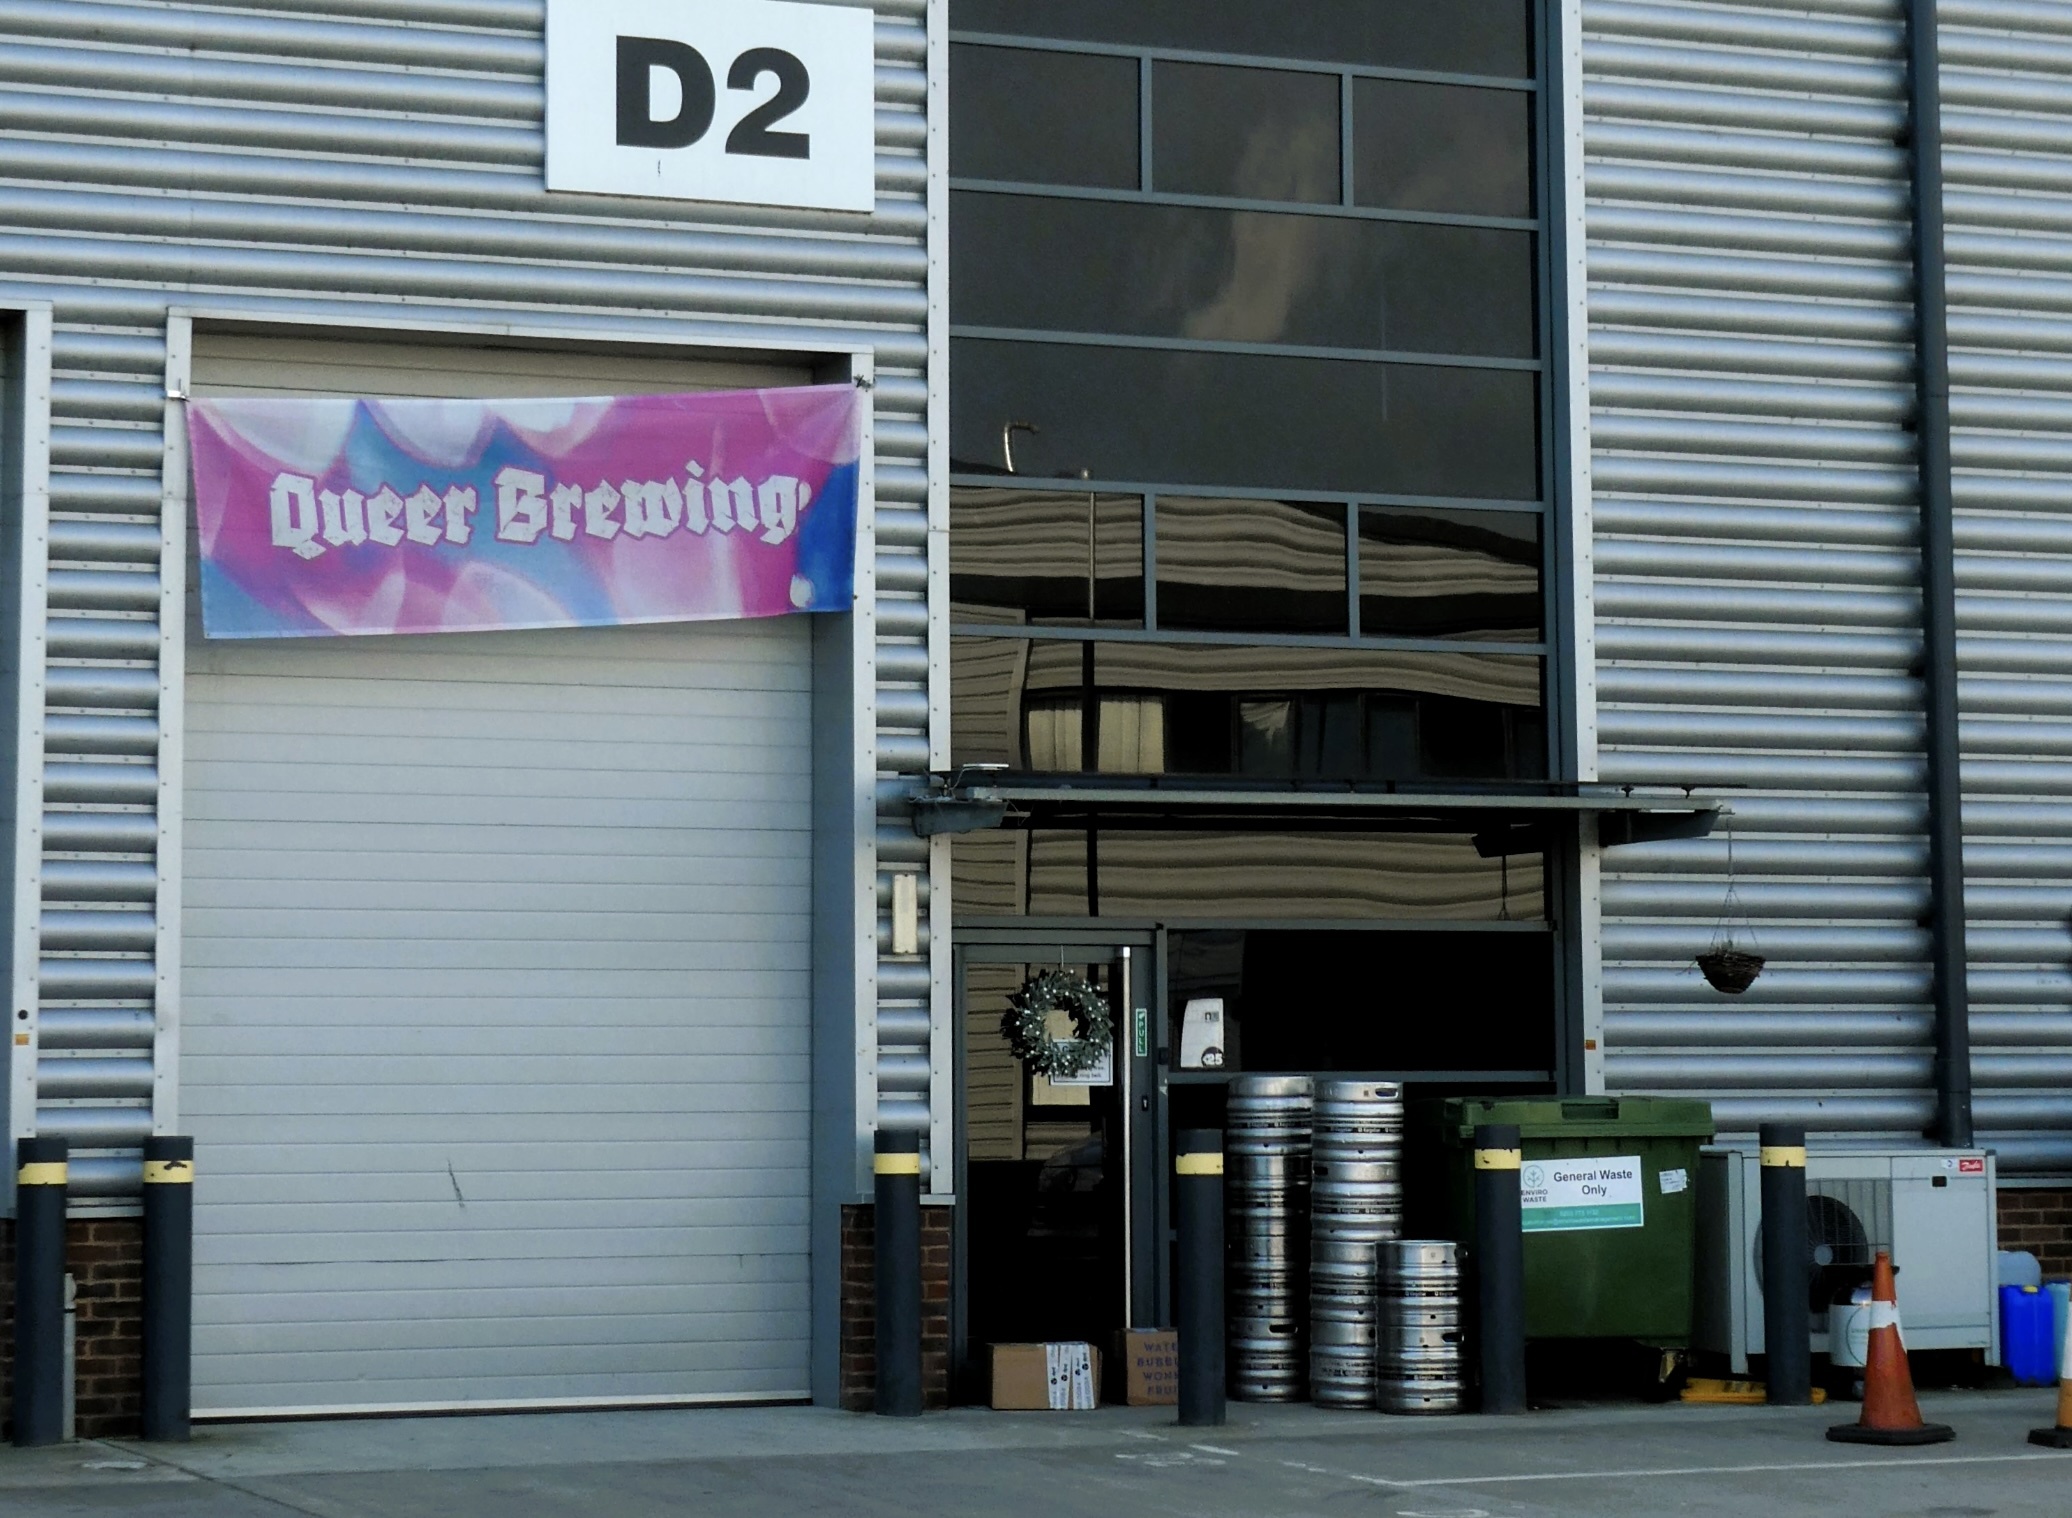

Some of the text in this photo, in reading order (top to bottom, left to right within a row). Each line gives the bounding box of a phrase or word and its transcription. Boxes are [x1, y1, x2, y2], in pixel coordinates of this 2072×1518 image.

[615, 35, 810, 160] D2
[271, 459, 811, 560] Queer Brewing
[1553, 1169, 1633, 1183] General Waste
[1520, 1188, 1548, 1197] ENVIRO
[1581, 1184, 1608, 1197] Only
